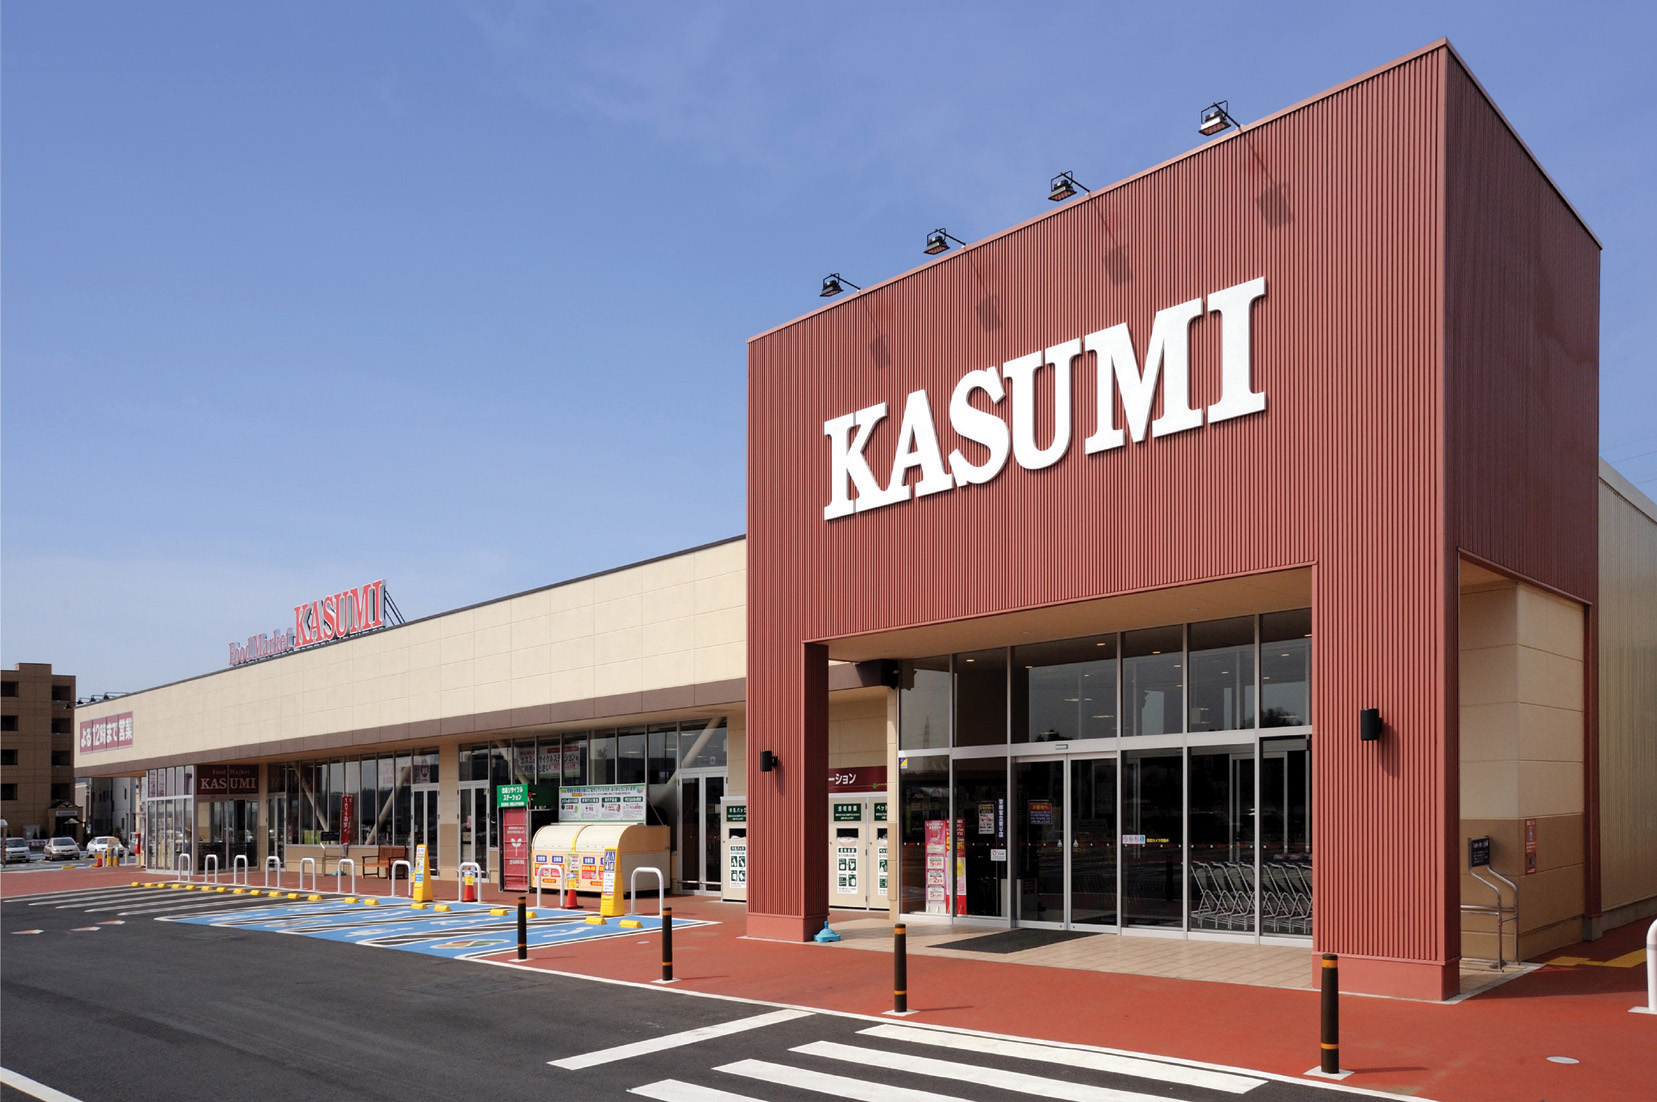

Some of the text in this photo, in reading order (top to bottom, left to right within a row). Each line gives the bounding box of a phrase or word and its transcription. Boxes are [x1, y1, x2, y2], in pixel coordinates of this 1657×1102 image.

[824, 276, 1267, 521] KASUMI
[228, 579, 385, 666] Food Market KASUMI
[81, 717, 133, 748] よる12時まで営業
[201, 777, 257, 790] KASUMI
